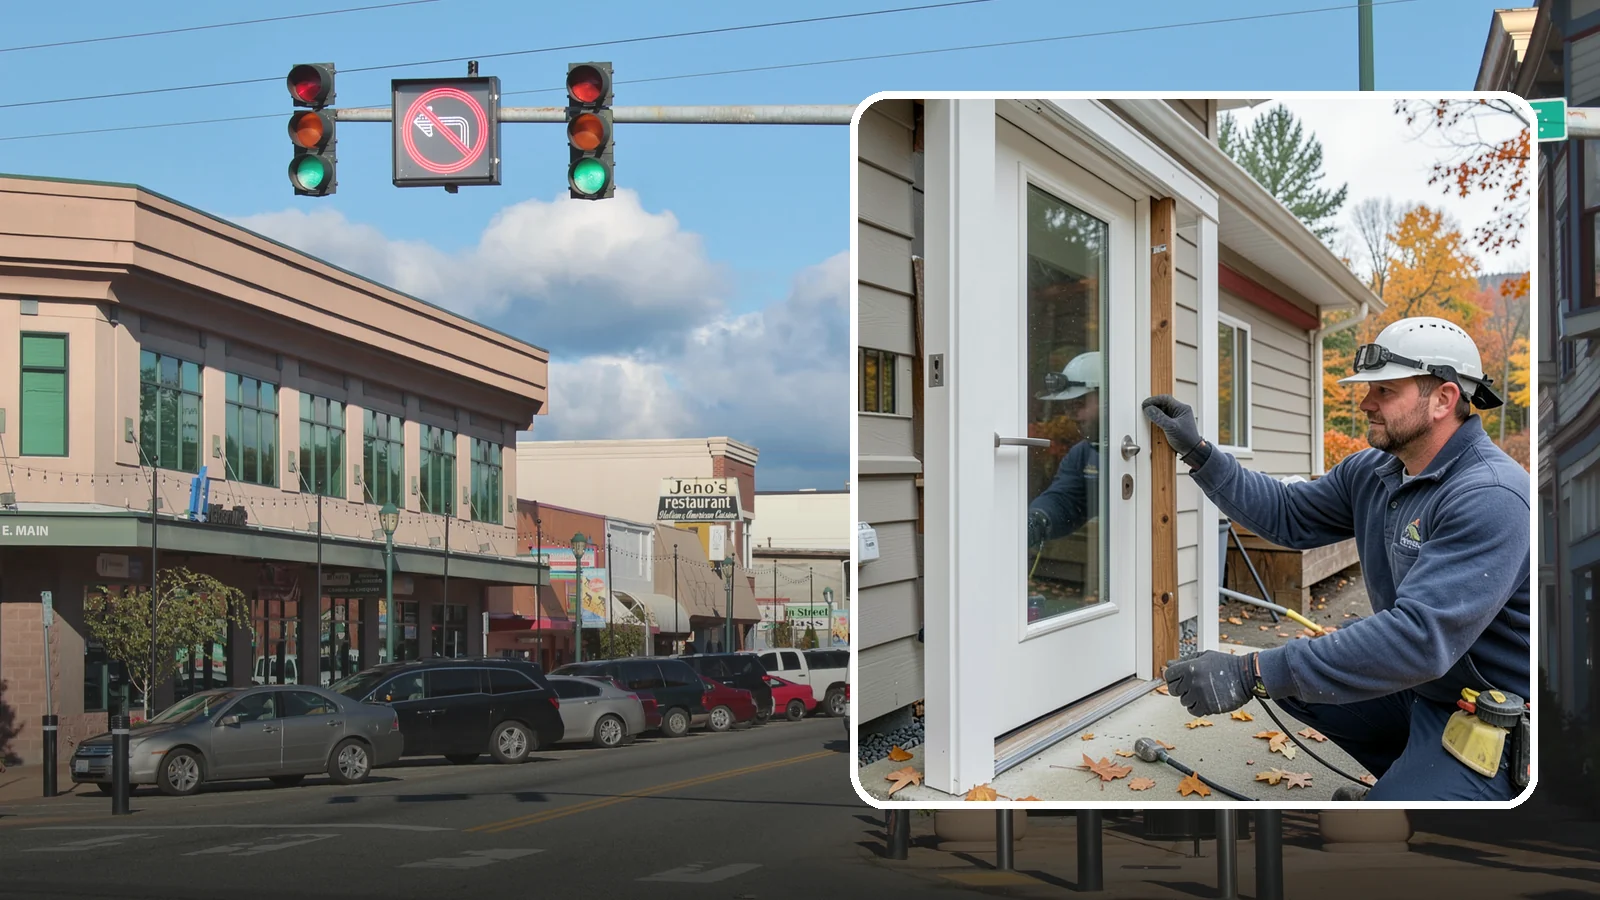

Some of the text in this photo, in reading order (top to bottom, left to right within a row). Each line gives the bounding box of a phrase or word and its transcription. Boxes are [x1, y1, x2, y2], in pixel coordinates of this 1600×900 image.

[670, 480, 727, 495] Jeno's
[665, 497, 731, 509] restaurant
[659, 510, 681, 519] Italian
[686, 509, 714, 519] American
[715, 510, 737, 519] Cuisine
[2, 525, 49, 536] E. MAIN
[797, 607, 828, 617] Street
